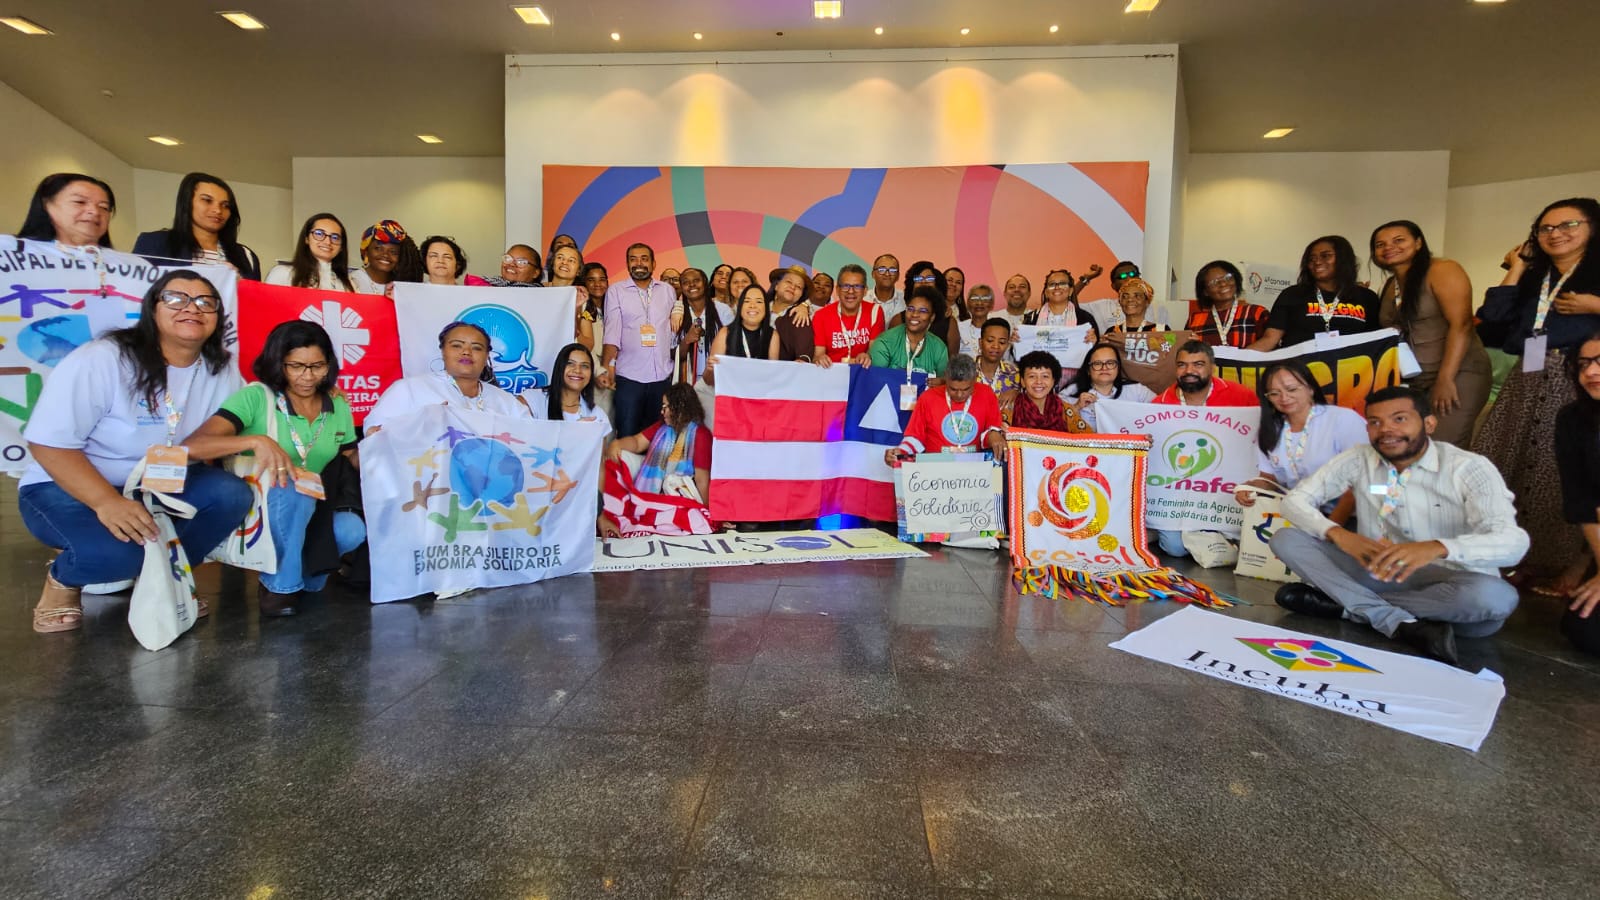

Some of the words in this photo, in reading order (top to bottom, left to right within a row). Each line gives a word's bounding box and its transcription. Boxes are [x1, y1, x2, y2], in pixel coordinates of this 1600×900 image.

[335, 375, 381, 390] TAS
[1134, 409, 1199, 430] SOMOS
[1204, 411, 1252, 437] MAIS
[908, 471, 990, 493] Economia
[1198, 500, 1208, 509] da
[1210, 514, 1223, 524] de
[414, 544, 449, 563] FUM
[453, 544, 538, 560] BRASILEIRO
[542, 544, 561, 558] DE
[414, 556, 477, 577] ENOMIA
